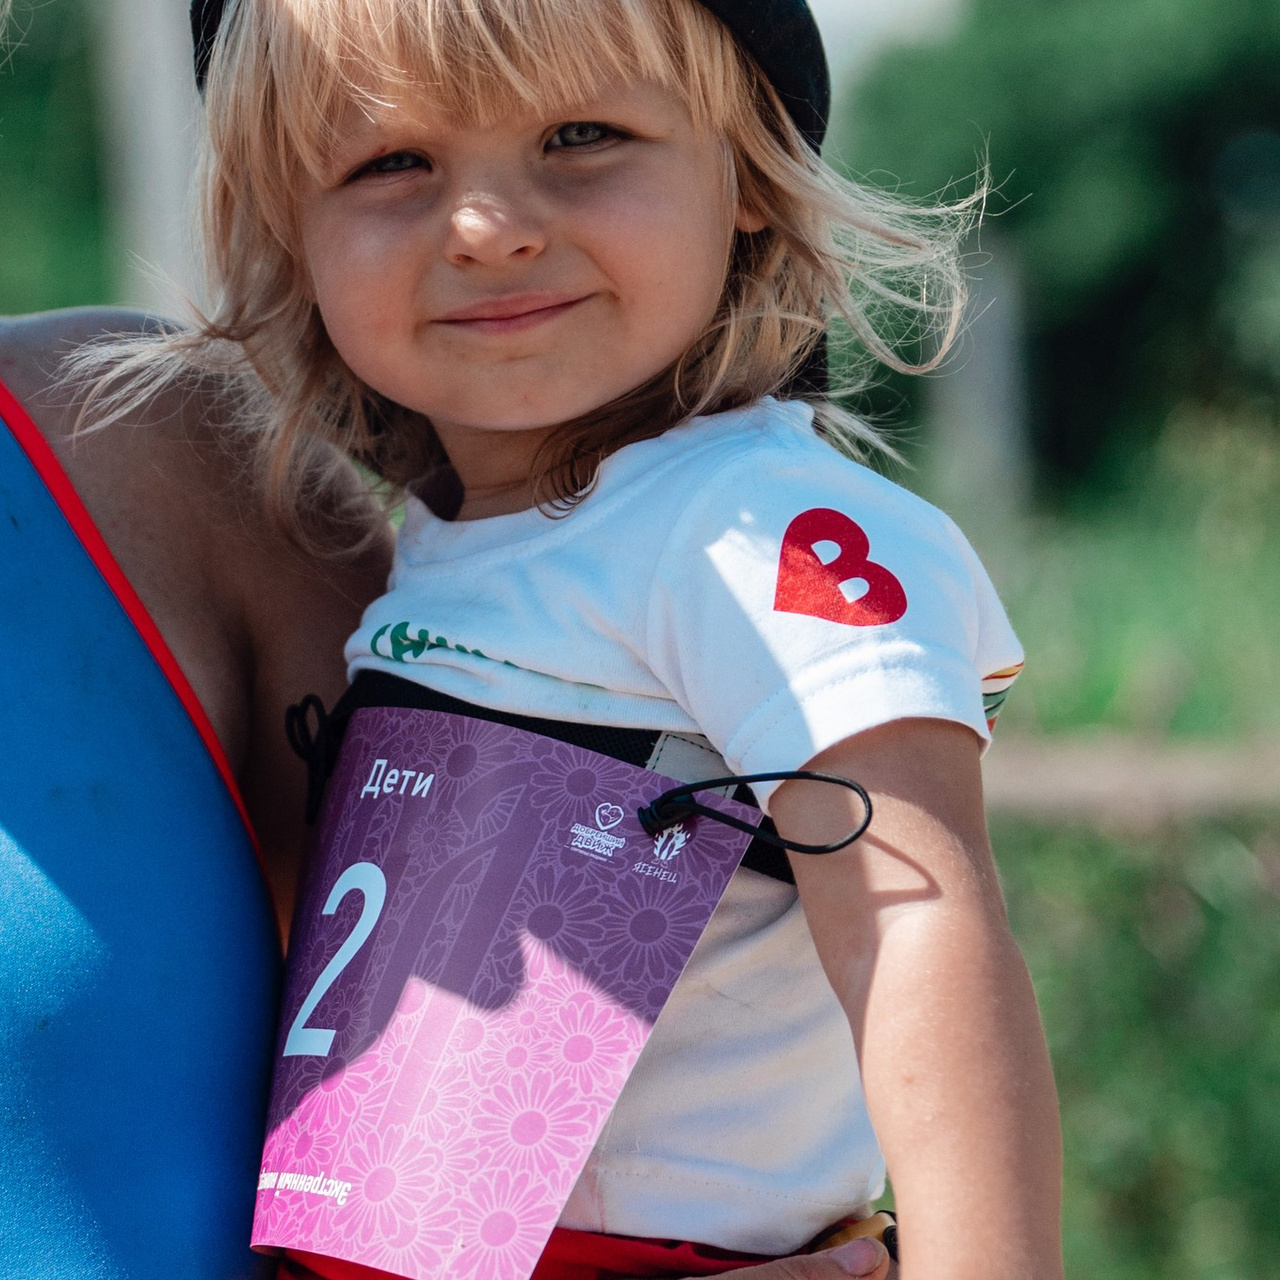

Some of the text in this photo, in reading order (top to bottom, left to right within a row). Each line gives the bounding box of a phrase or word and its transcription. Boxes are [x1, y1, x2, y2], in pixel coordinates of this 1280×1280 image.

[360, 759, 434, 799] Дети
[631, 861, 678, 883] ЯСЕНЕЦ
[282, 861, 387, 1057] 2
[274, 1171, 352, 1206] Экстренный
